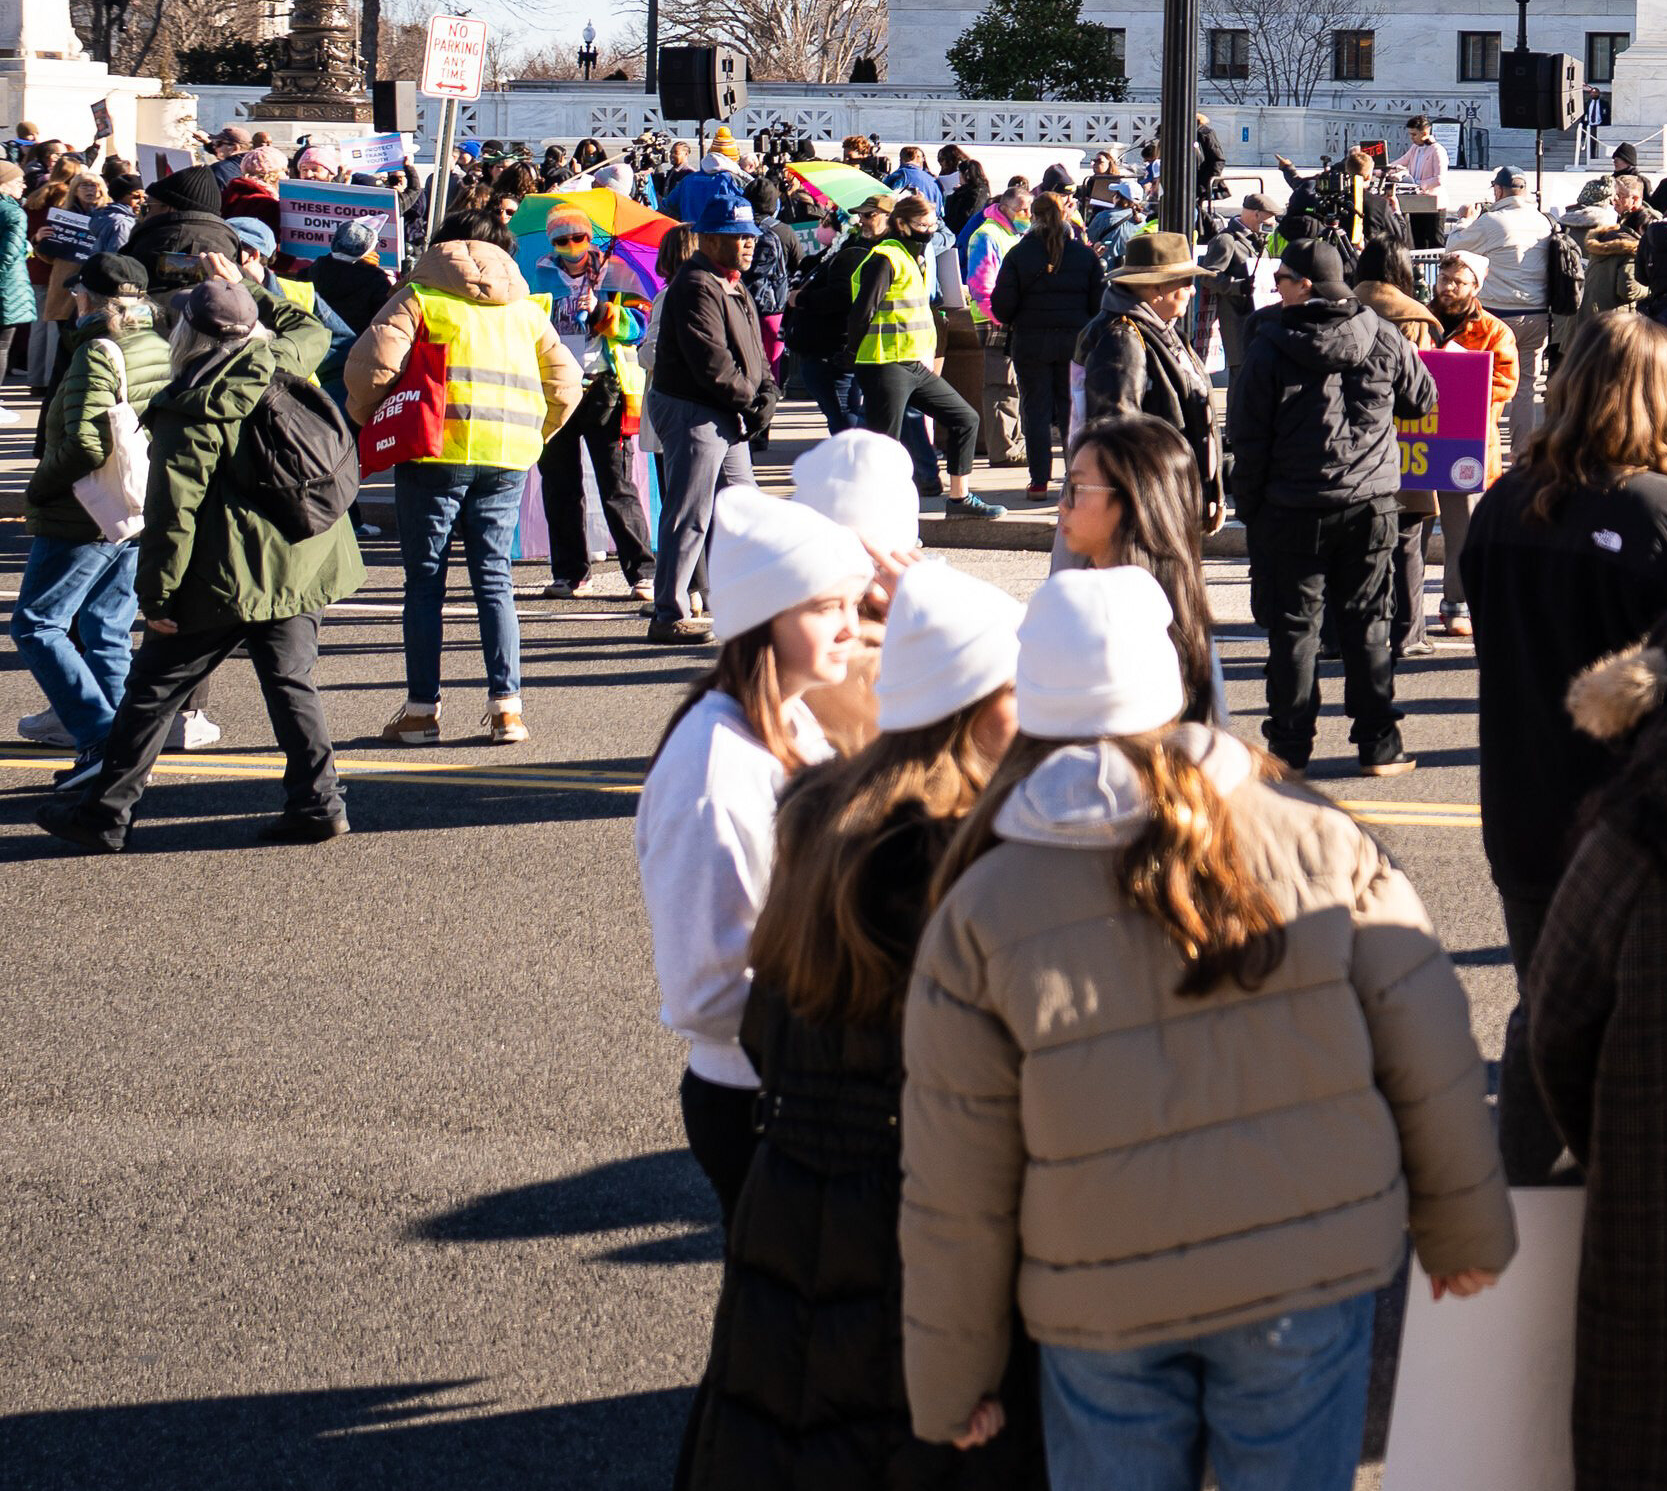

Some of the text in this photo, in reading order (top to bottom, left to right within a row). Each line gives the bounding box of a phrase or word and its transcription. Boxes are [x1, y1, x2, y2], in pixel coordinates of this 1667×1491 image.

[448, 23, 469, 39] NO
[433, 37, 480, 56] PARKING
[443, 56, 466, 68] ANY
[440, 67, 467, 81] TIME
[365, 151, 388, 159] TRANS
[290, 201, 332, 214] THESE
[290, 230, 325, 243] FROM
[372, 402, 404, 425] TO BE
[375, 435, 396, 452] ACLU
